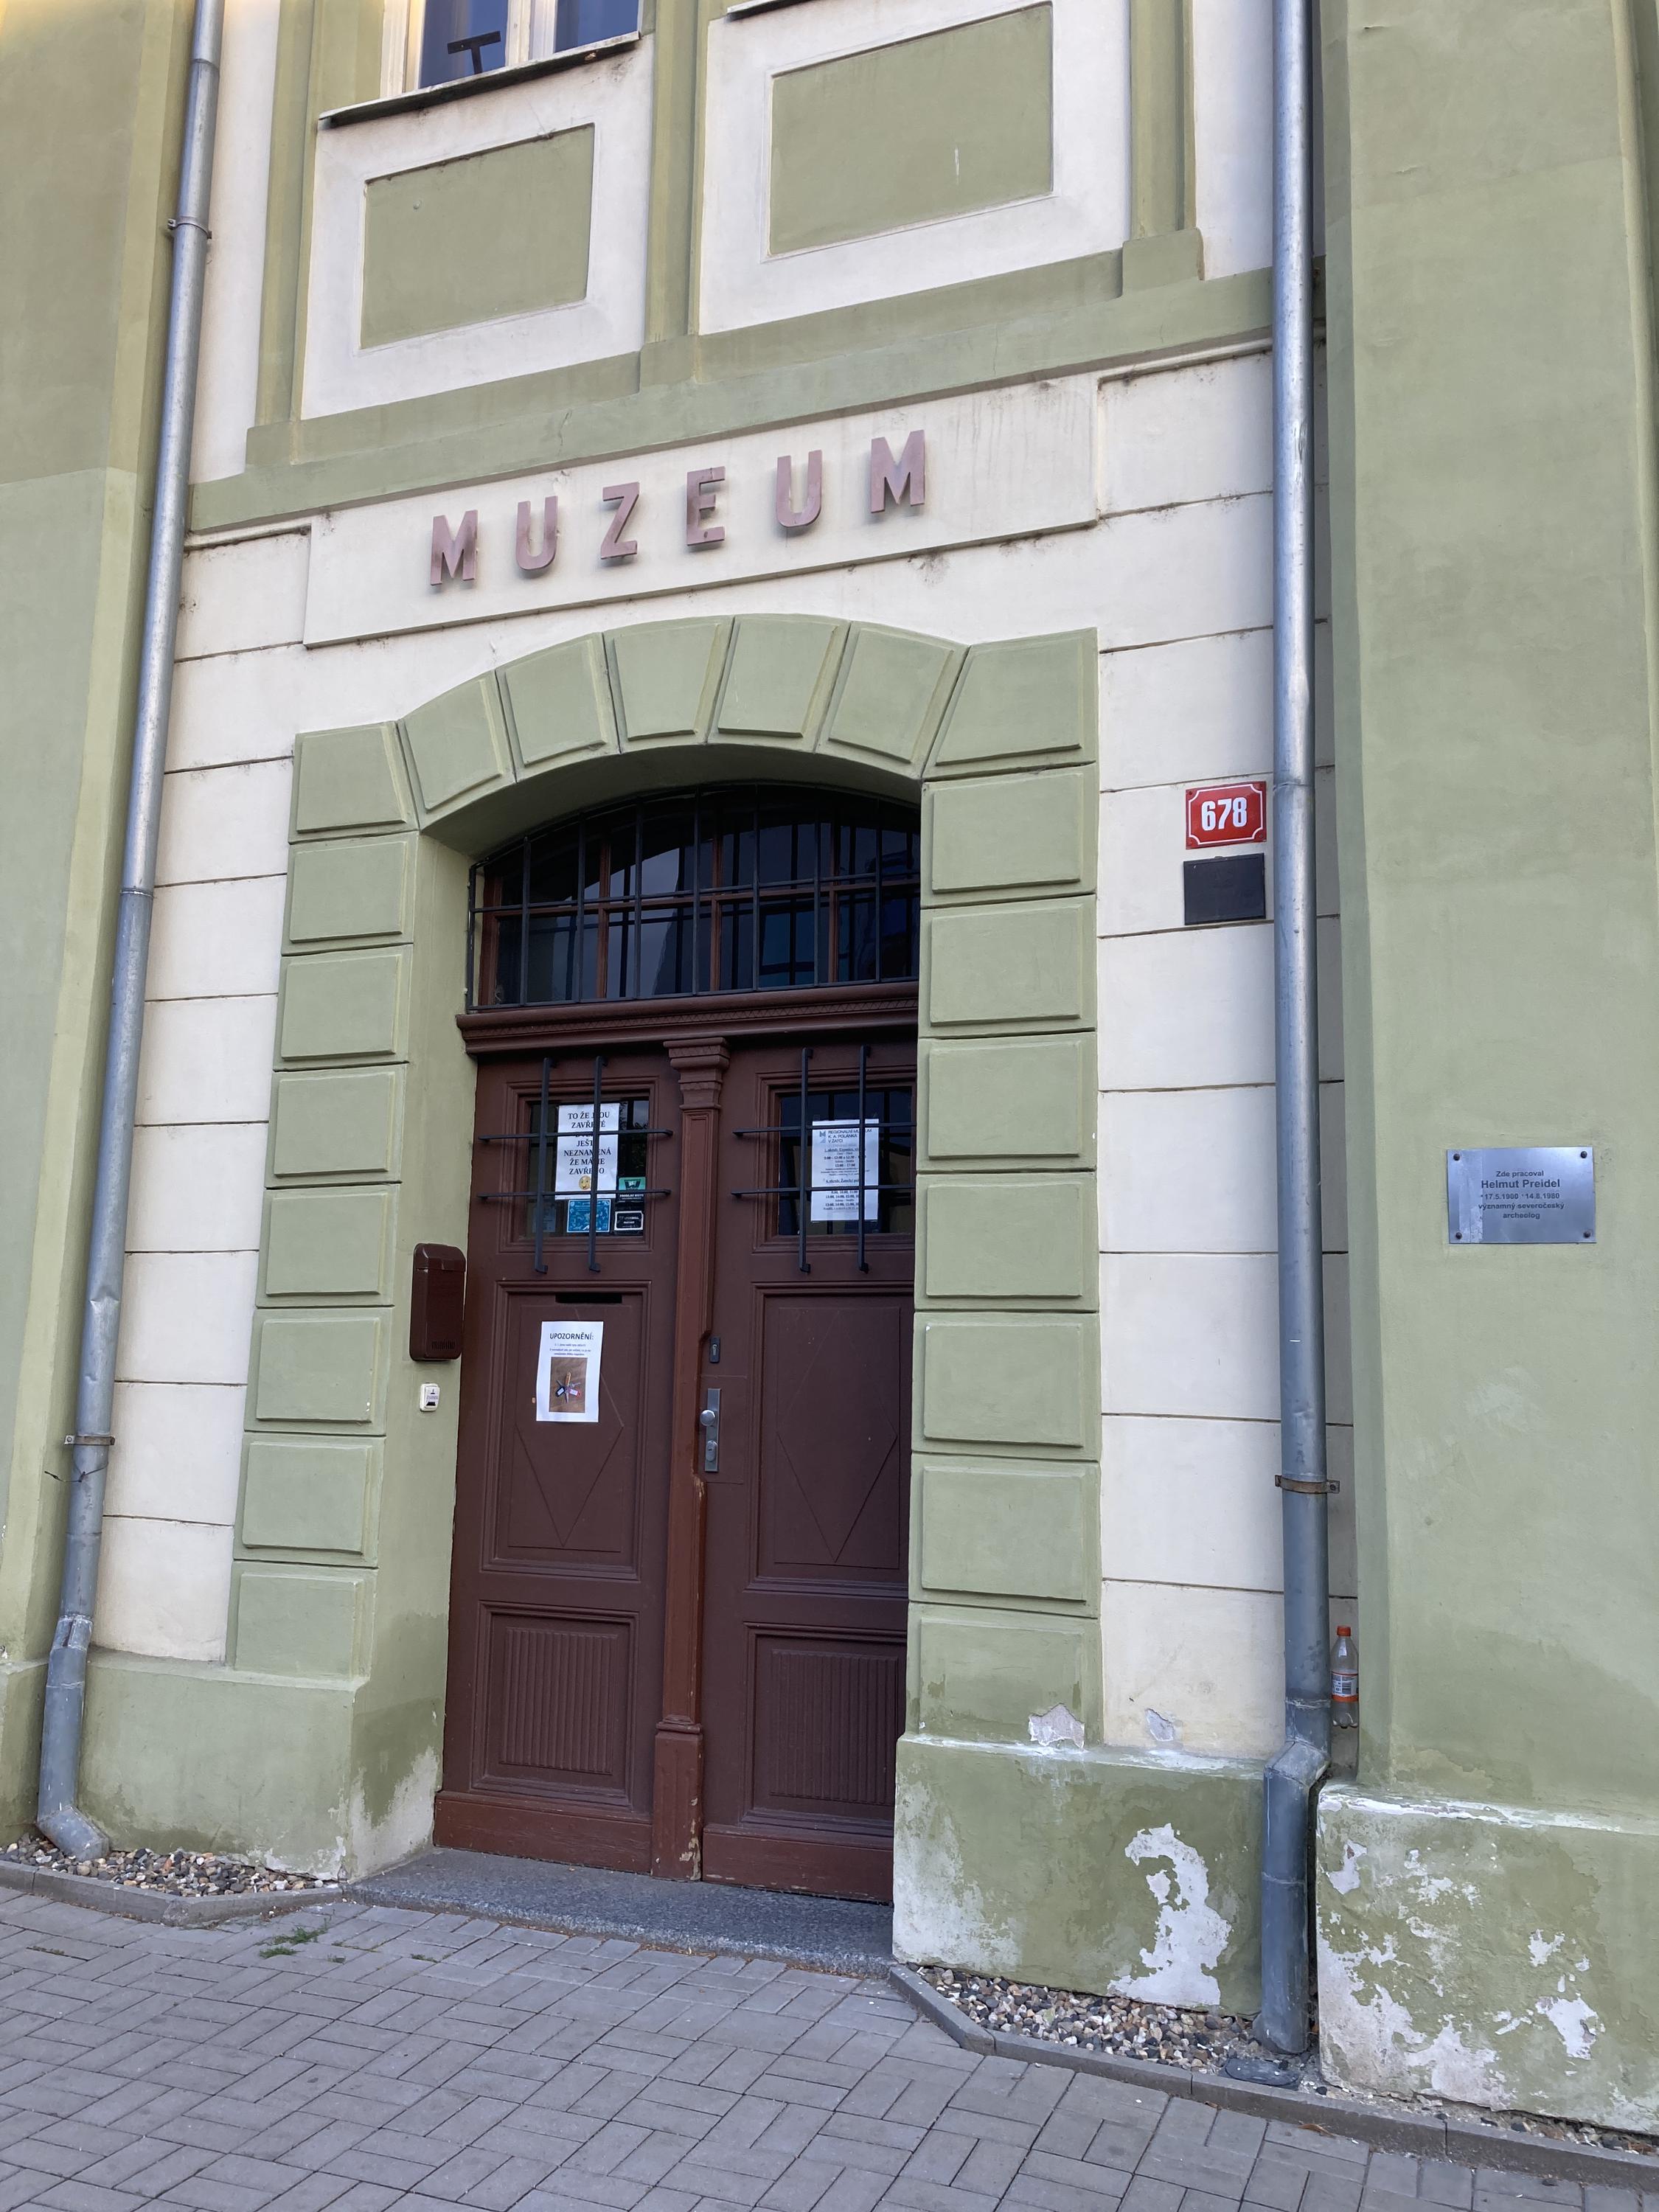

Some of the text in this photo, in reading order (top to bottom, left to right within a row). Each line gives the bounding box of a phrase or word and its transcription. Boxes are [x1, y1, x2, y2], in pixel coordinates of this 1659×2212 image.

[430, 429, 926, 586] MUZEUM
[1201, 797, 1248, 831] 678
[580, 1111, 589, 1119] ŽE
[569, 1158, 580, 1166] ŽE
[1512, 1170, 1544, 1178] pracoval
[1481, 1179, 1560, 1189] Helmut Preidel
[549, 1332, 594, 1340] UPOZORNĚNÍ:
